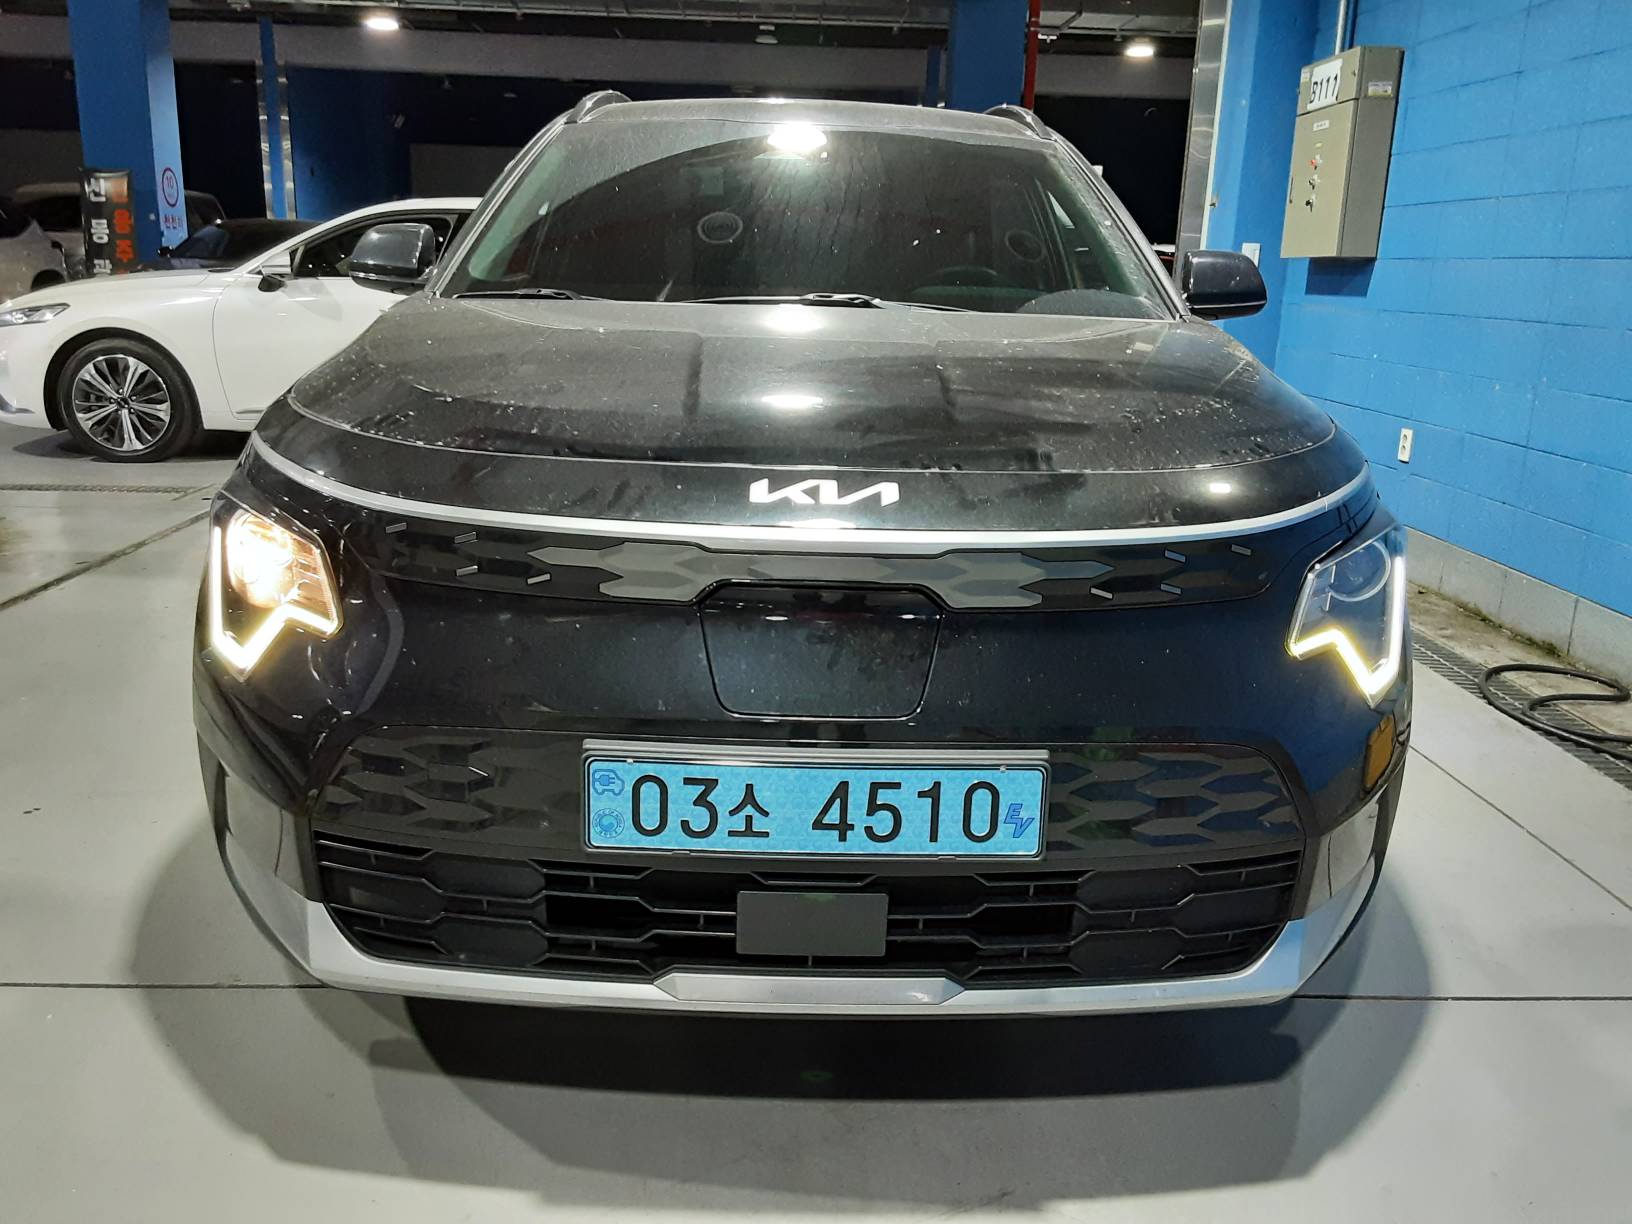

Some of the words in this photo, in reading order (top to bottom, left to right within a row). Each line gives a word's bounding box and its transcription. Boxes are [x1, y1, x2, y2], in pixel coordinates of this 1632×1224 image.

[749, 477, 900, 508] KIA
[631, 774, 770, 840] 03소
[811, 780, 1000, 844] 4510
[1003, 802, 1035, 839] EV
